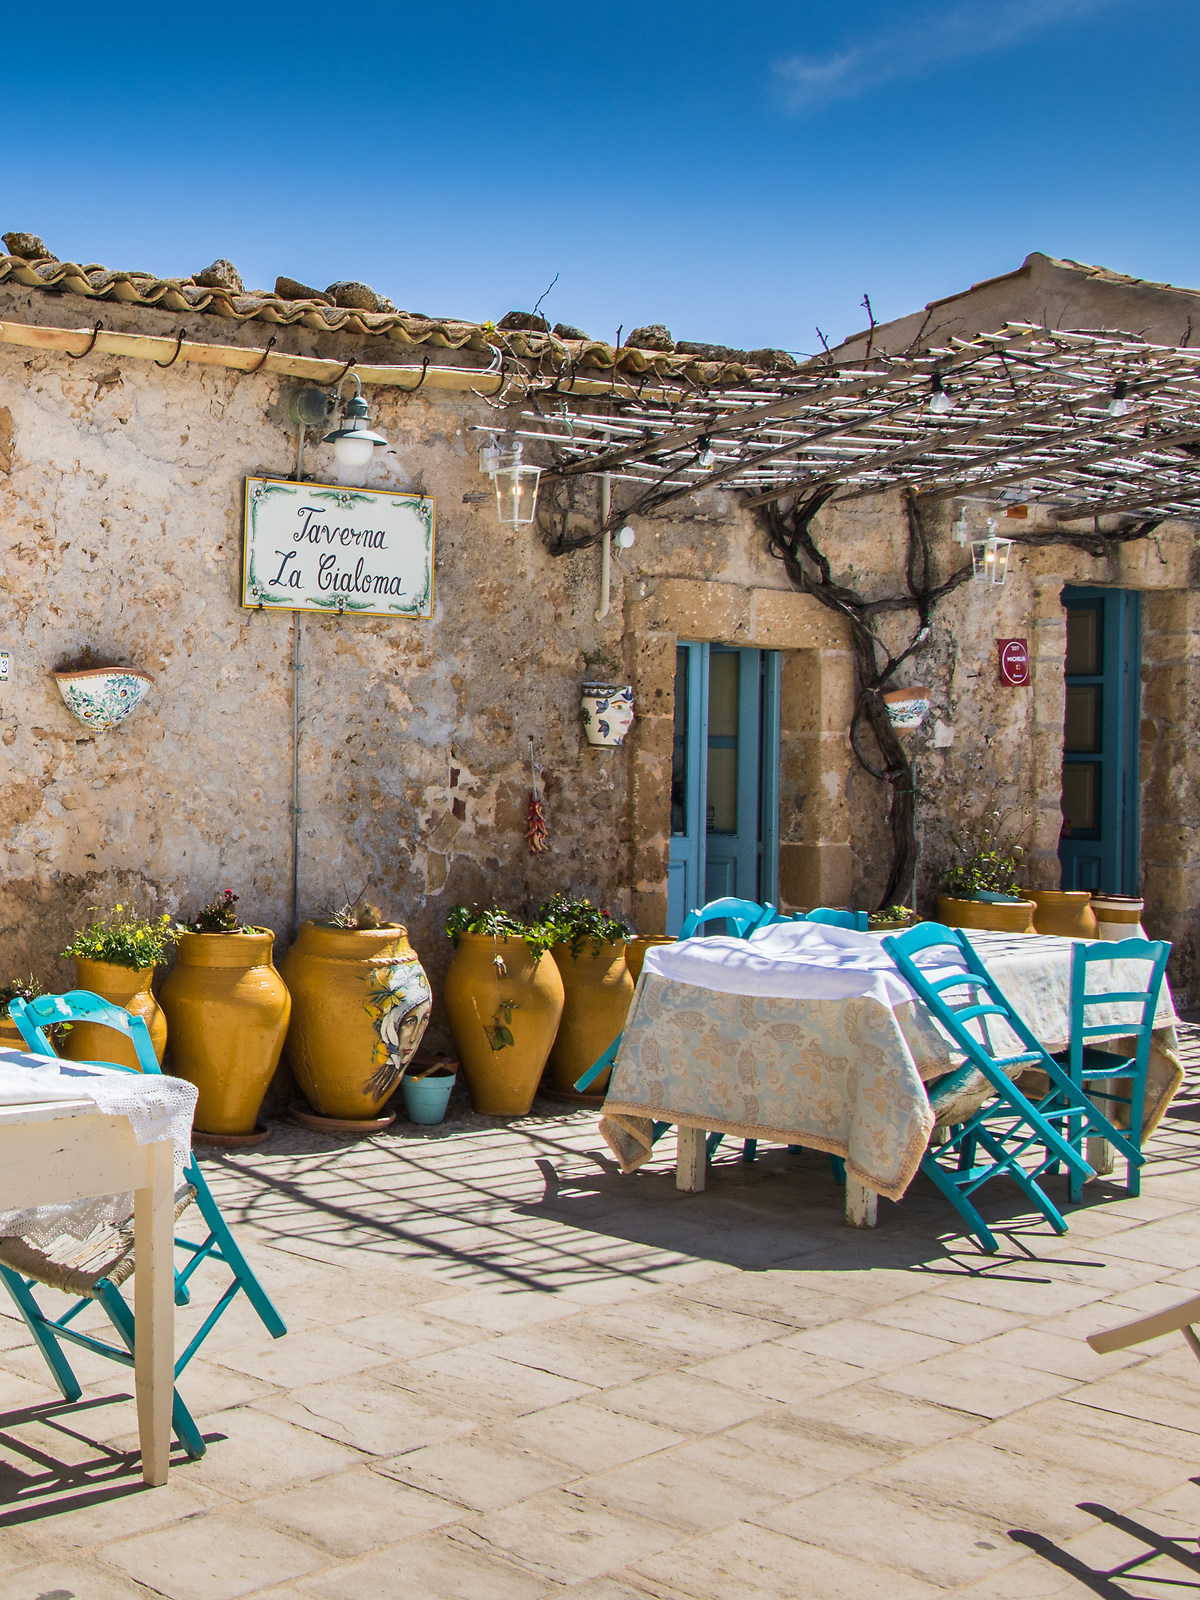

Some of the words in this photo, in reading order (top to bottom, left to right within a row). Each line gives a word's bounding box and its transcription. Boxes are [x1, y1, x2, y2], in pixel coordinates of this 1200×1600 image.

[293, 506, 388, 549] Taverna
[268, 550, 305, 589] La
[318, 553, 407, 595] Cialoma
